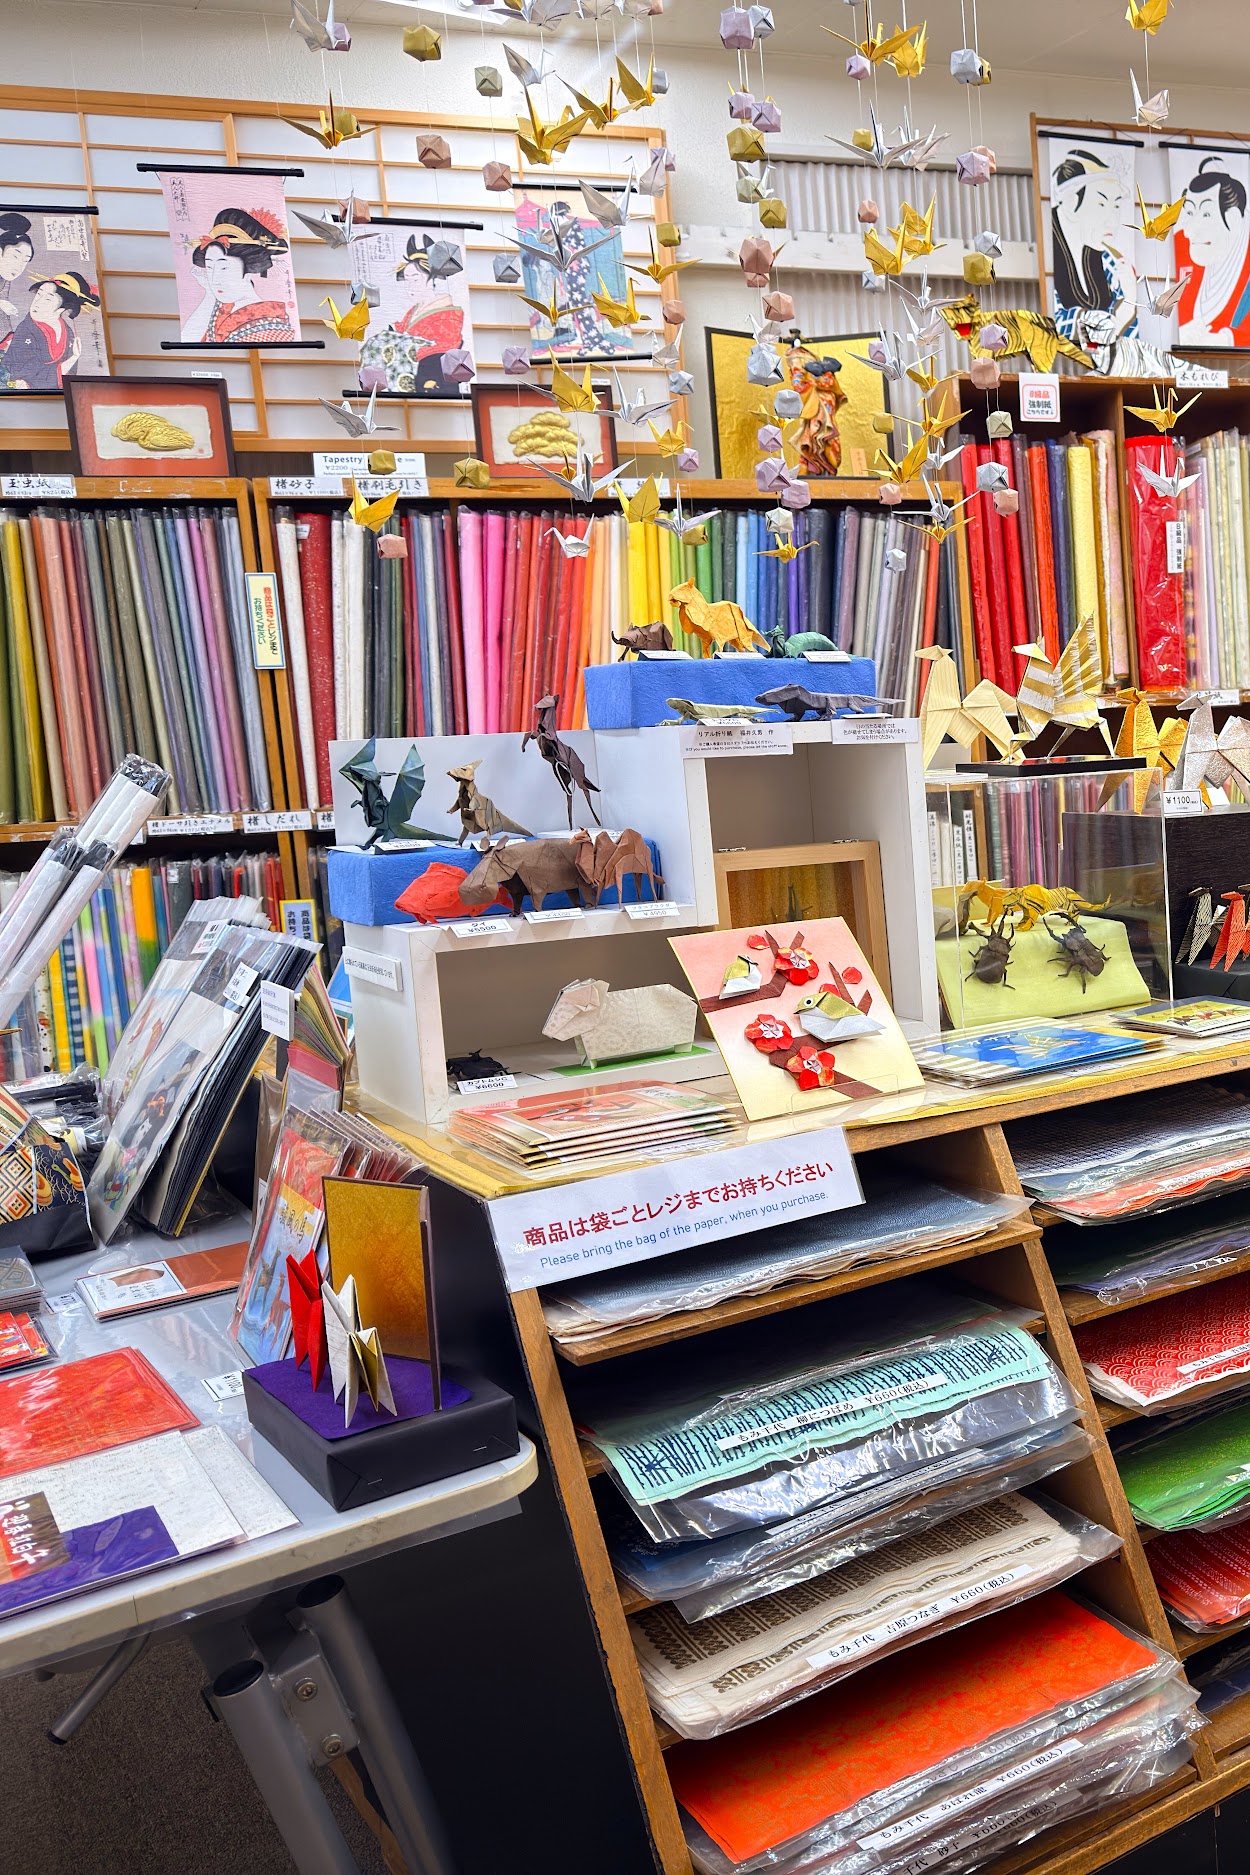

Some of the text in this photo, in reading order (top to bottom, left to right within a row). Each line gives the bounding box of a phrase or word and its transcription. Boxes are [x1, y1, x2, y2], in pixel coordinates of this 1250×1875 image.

[323, 455, 363, 465] Tapestry
[1166, 796, 1190, 804] ¥1100
[523, 1161, 834, 1246] 商品は袋ごとレジまでお持ちください
[540, 1189, 829, 1268] Please bring the bag of the paper, when you purchase.
[738, 1380, 930, 1442] もみ千代 柳につばめ ¥660(税込)
[828, 1573, 1016, 1659] もみ千代 吉原つなぎ ¥660(税込)
[880, 1812, 930, 1840] もみ千代
[996, 1747, 1064, 1782] ¥660(税込)
